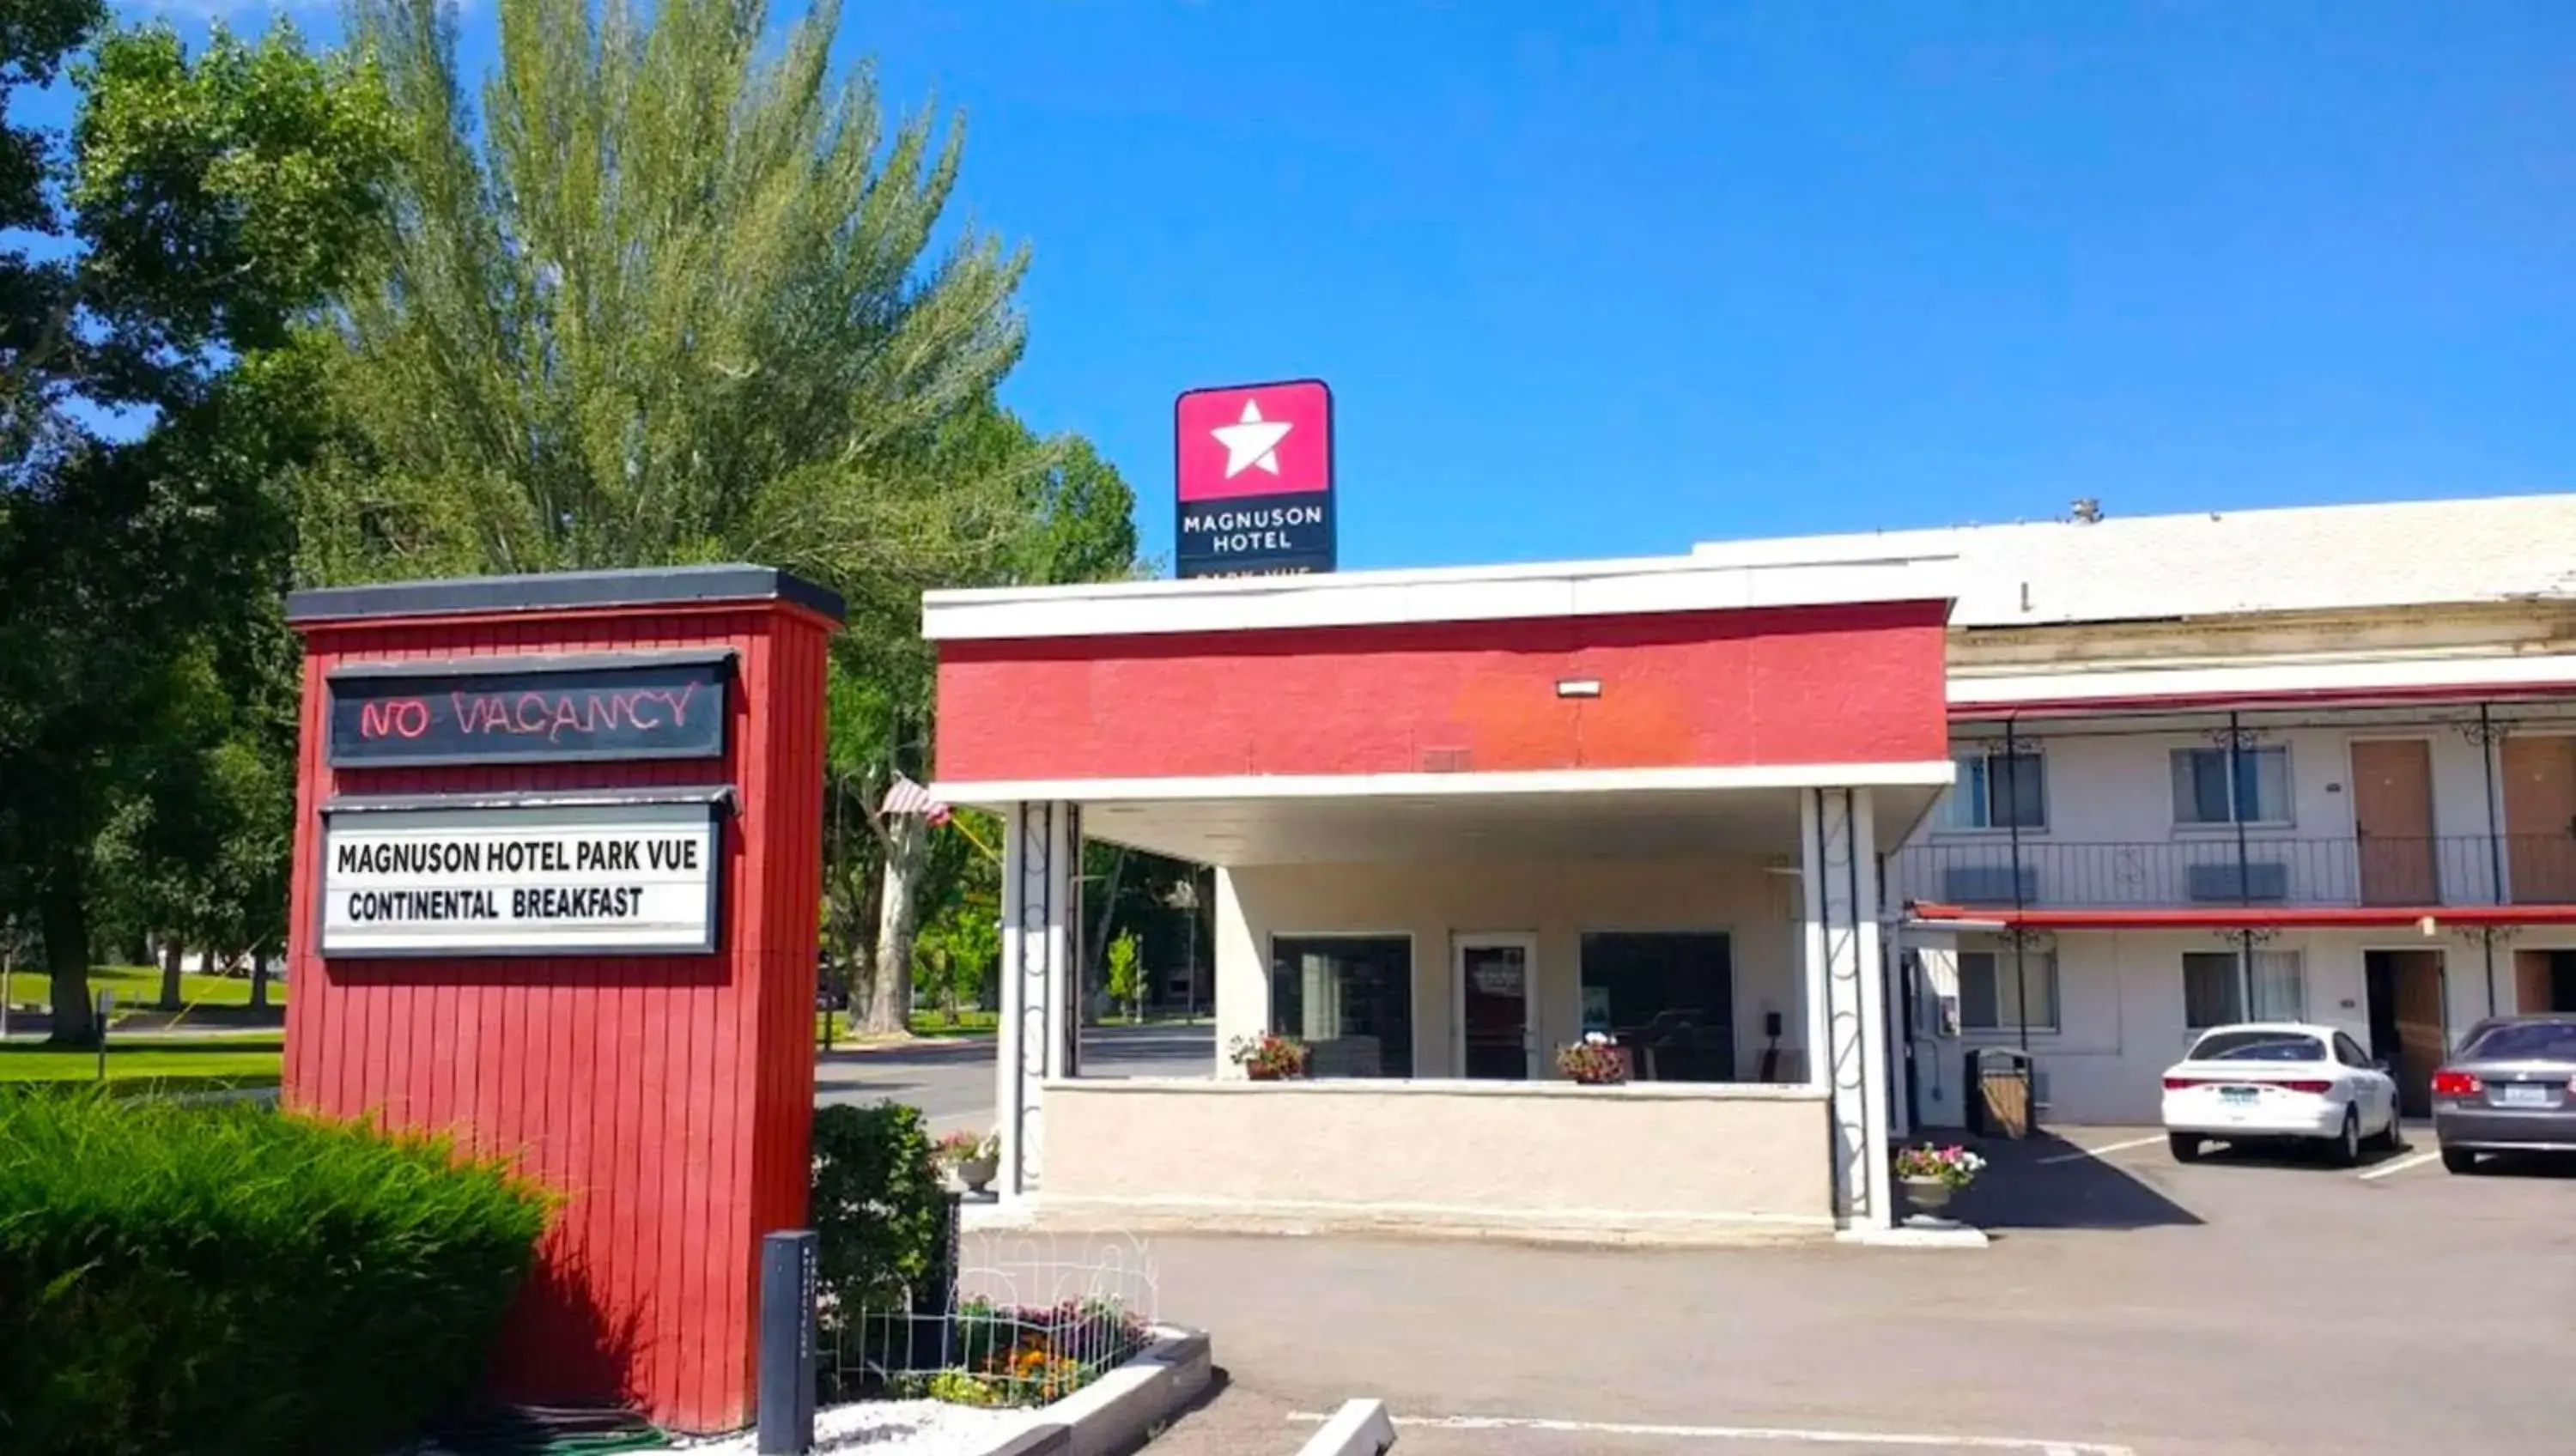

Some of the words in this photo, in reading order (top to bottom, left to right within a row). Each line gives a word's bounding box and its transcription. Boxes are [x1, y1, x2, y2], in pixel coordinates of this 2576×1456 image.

[1183, 506, 1321, 533] MAGNUSON
[1213, 531, 1291, 553] HOTEL
[361, 699, 428, 738] NO
[451, 682, 702, 743] VACANCY
[337, 842, 479, 873] MAGNUSON
[487, 841, 570, 872] HOTEL
[576, 840, 640, 871] PARK
[647, 840, 697, 870] VUE
[349, 889, 499, 921] CONTINENTAL
[512, 887, 643, 918] BREAKFAST
